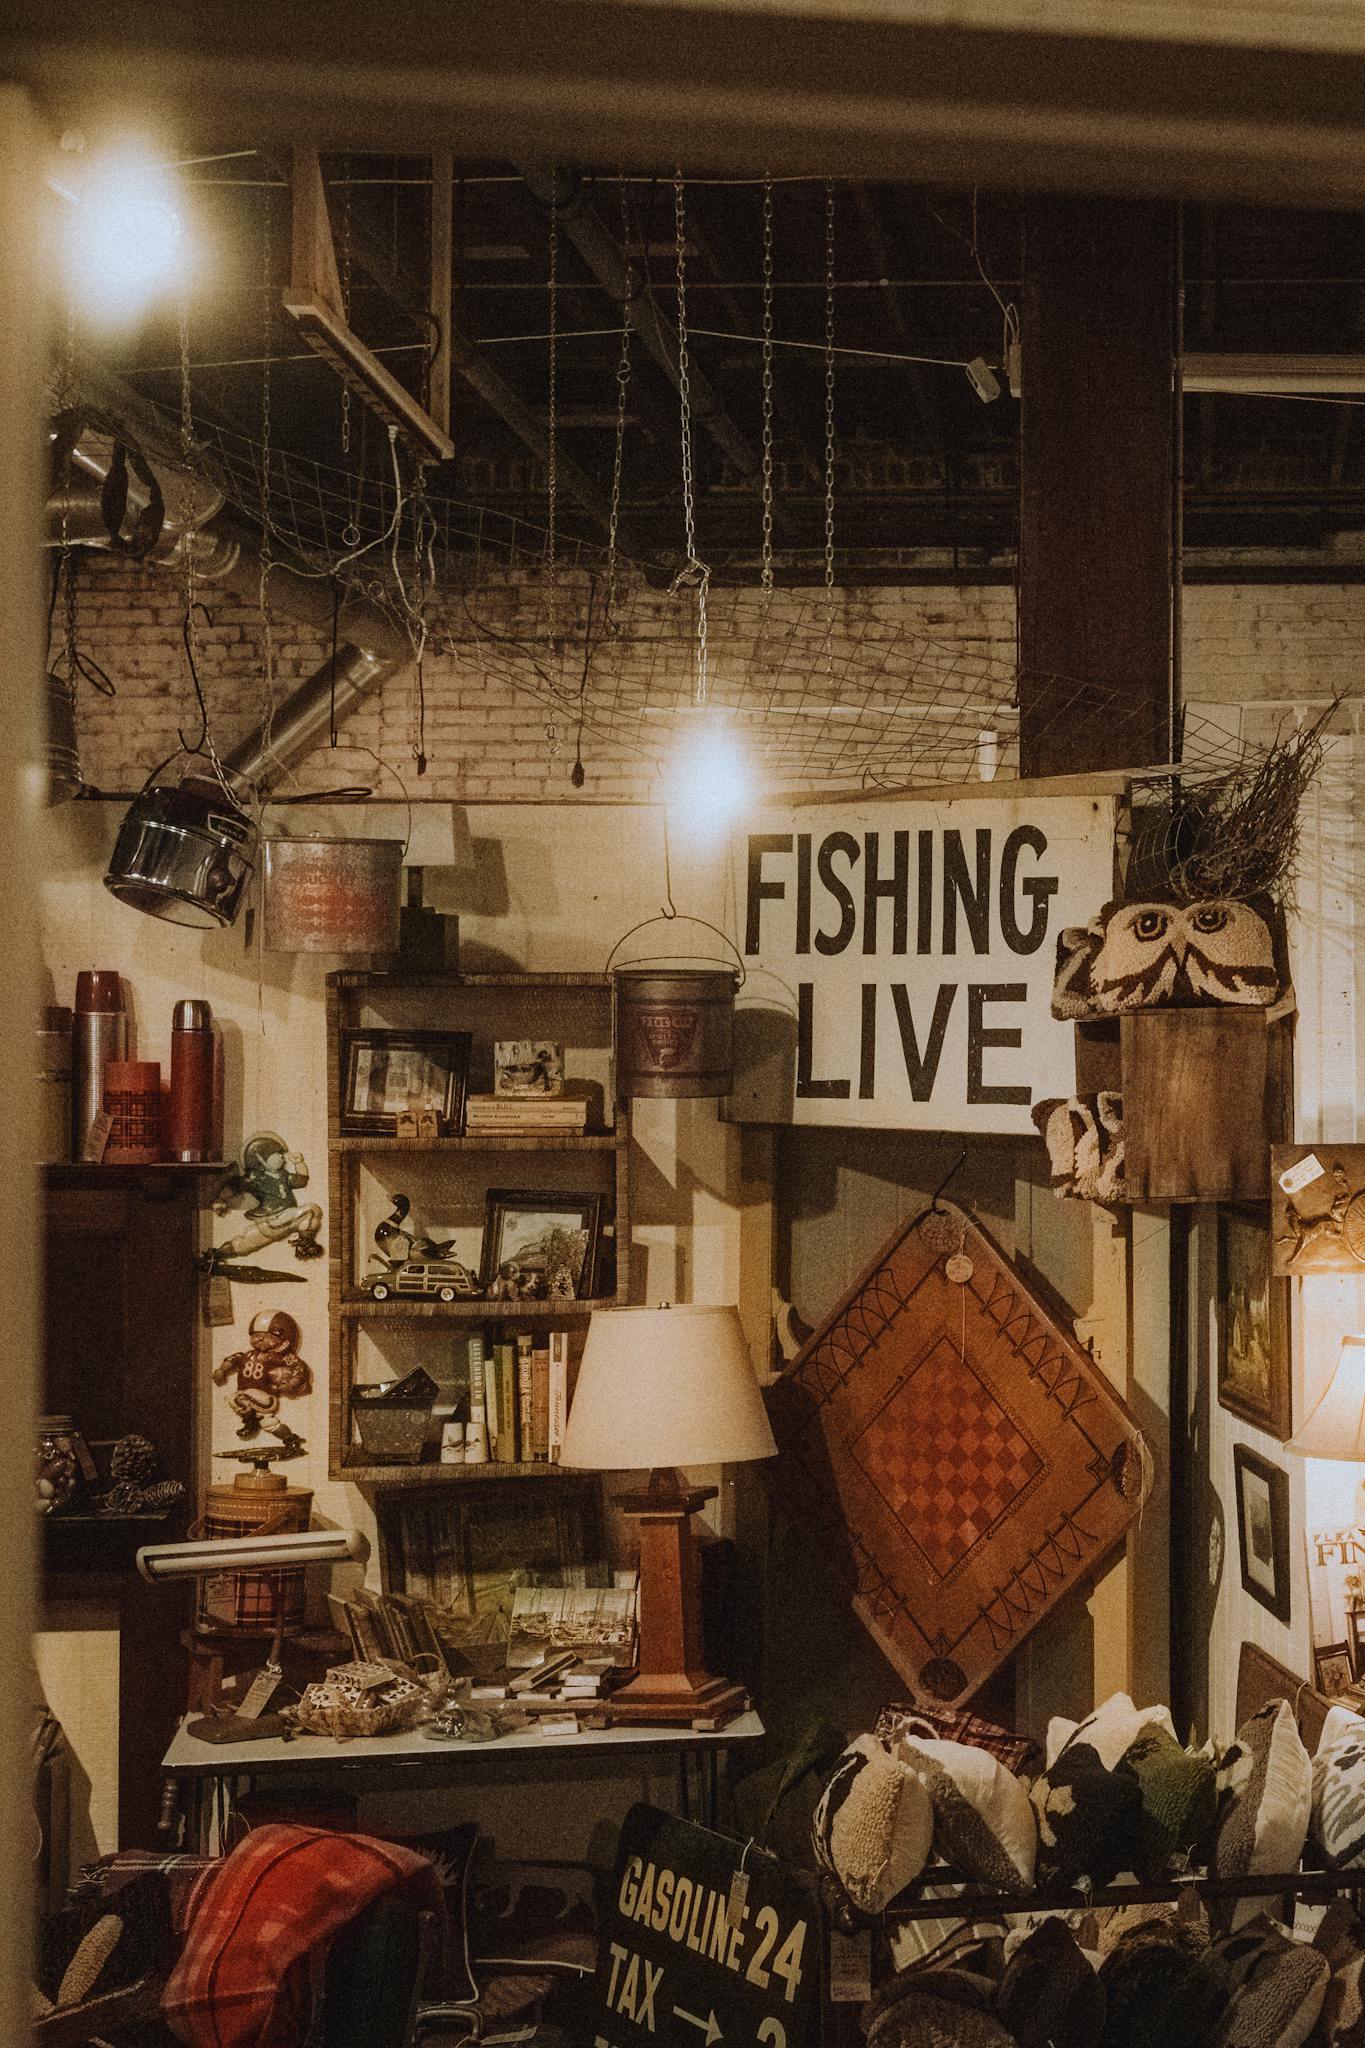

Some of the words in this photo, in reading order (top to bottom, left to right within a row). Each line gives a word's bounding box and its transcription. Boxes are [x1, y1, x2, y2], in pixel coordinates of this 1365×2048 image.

[745, 824, 1059, 956] FISHING
[796, 983, 1032, 1105] LIVE
[472, 1343, 483, 1388] LISTENING
[553, 1390, 563, 1437] Tennessee
[618, 1855, 750, 1972] GASOLINE
[745, 1905, 807, 2003] 24
[606, 1942, 664, 2032] TAX
